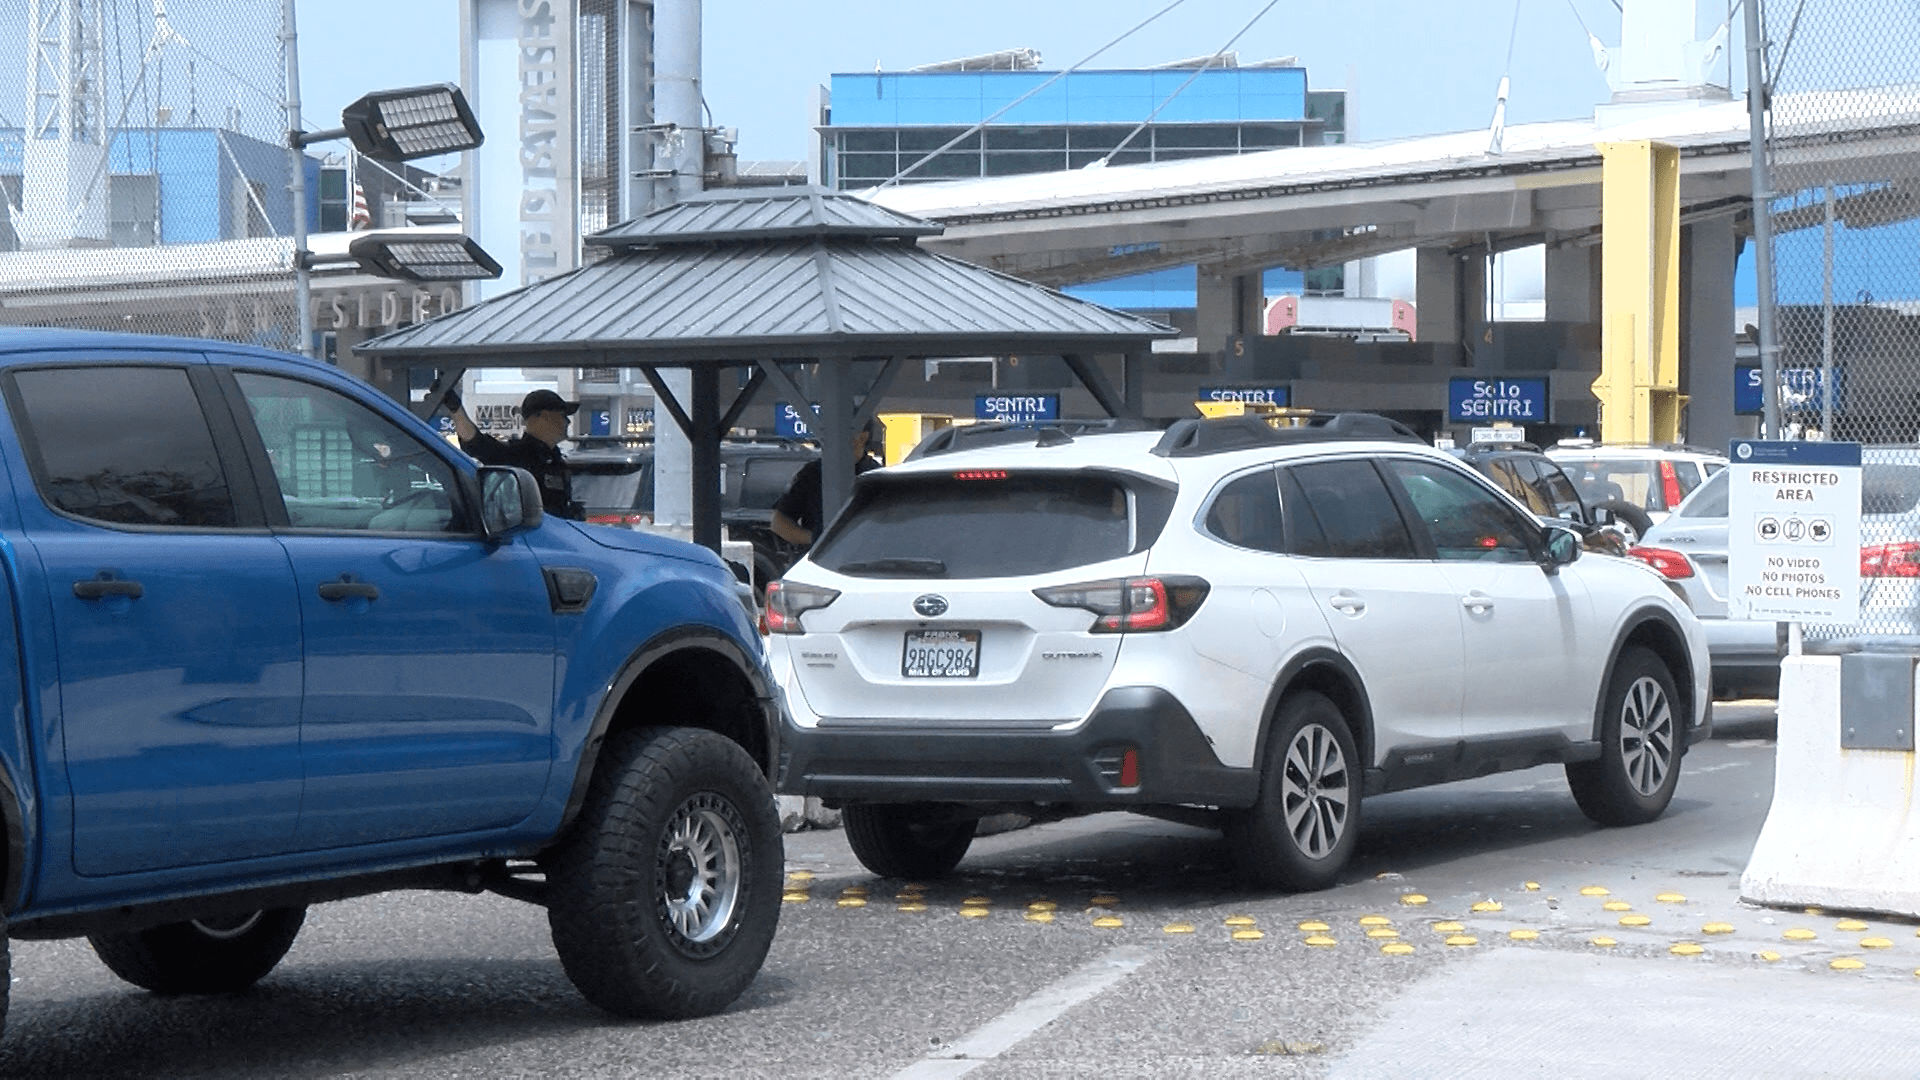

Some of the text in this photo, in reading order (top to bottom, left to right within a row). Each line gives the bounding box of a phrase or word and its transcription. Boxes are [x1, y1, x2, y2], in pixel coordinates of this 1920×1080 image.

[1235, 341, 1244, 356] 5
[1210, 389, 1276, 403] SENTRI
[1473, 381, 1520, 398] Solo
[985, 396, 1046, 412] SENTRI
[1461, 399, 1533, 416] SENTRI
[1752, 471, 1839, 485] RESTRICTED
[1775, 489, 1814, 501] AREA
[1768, 557, 1820, 569] NO VIDEO
[1762, 571, 1825, 584] NO PHOTOS
[1746, 585, 1841, 600] NO CELL PHONES
[908, 648, 974, 670] 9BGC986
